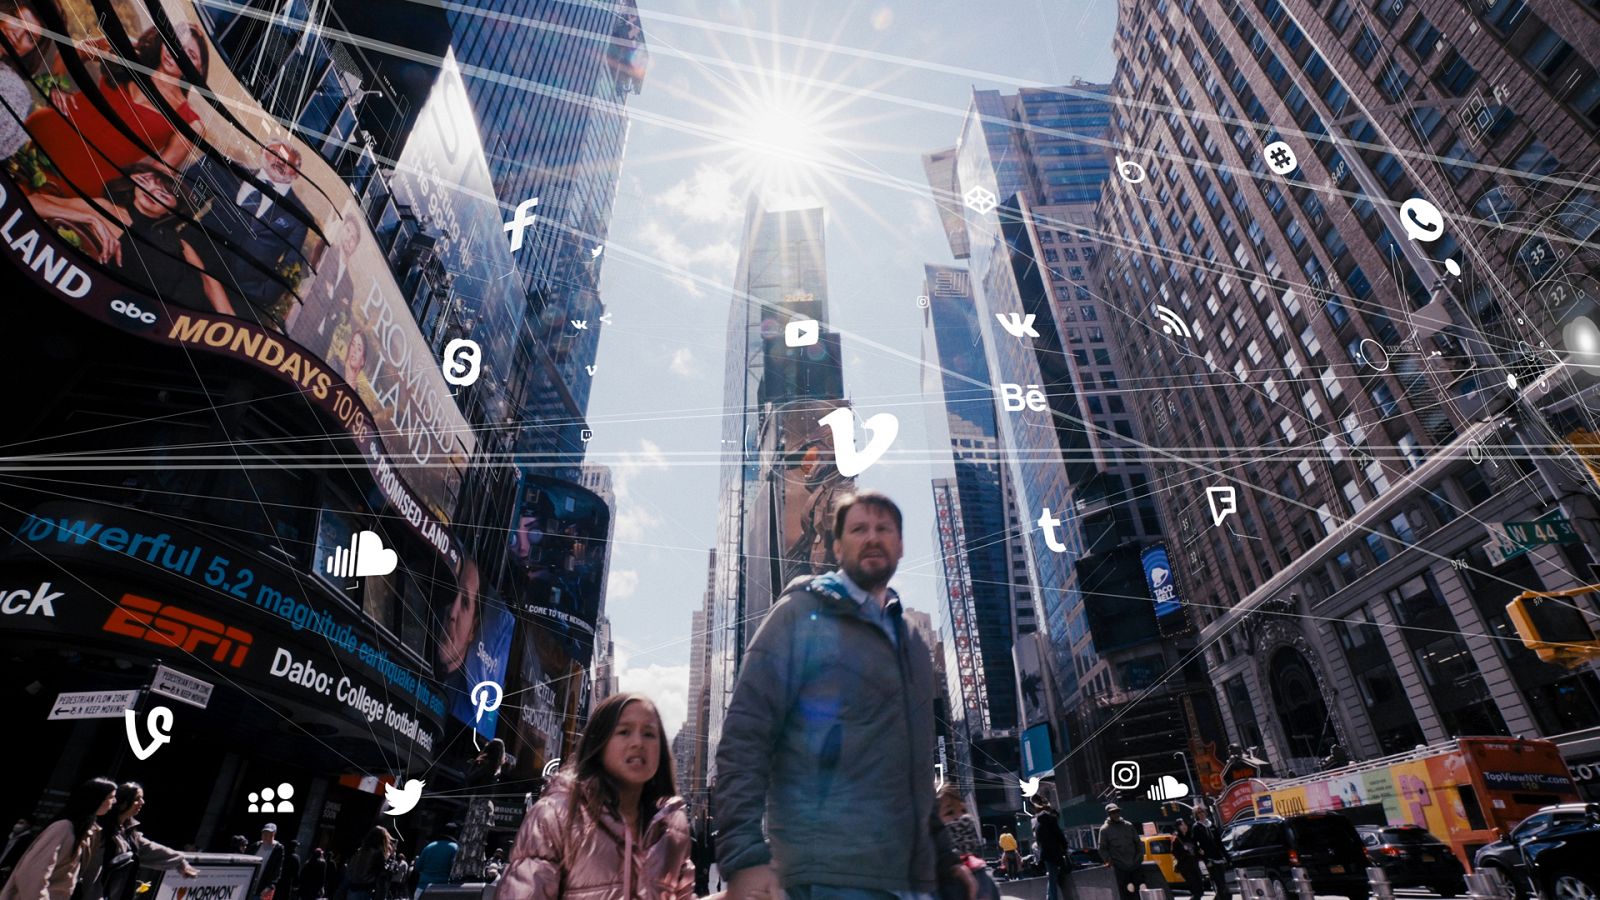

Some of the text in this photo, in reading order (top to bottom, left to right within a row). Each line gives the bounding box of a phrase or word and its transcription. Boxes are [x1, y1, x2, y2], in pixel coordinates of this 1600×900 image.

[0, 208, 92, 299] LAND
[110, 299, 157, 324] abc
[361, 279, 457, 453] PROMISED
[370, 352, 431, 465] LAND
[168, 315, 332, 400] MONDAYS
[333, 389, 369, 444] 10/9c
[376, 455, 423, 528] PROMISED
[420, 516, 450, 555] LAND
[1507, 524, 1528, 543] W
[1534, 523, 1559, 542] 44
[204, 555, 254, 599] 5.2
[255, 584, 358, 654] magnitude
[1153, 584, 1174, 598] TACO
[1156, 592, 1176, 604] BELL
[102, 593, 254, 668] ESPN
[269, 647, 334, 696] Dabo:
[336, 676, 385, 723] College
[384, 702, 420, 747] football
[476, 641, 498, 674] Sleepy?
[58, 695, 95, 705] PEDESTRIAN
[83, 705, 100, 714] KEEP
[1483, 771, 1570, 785] TopViewNYC.com
